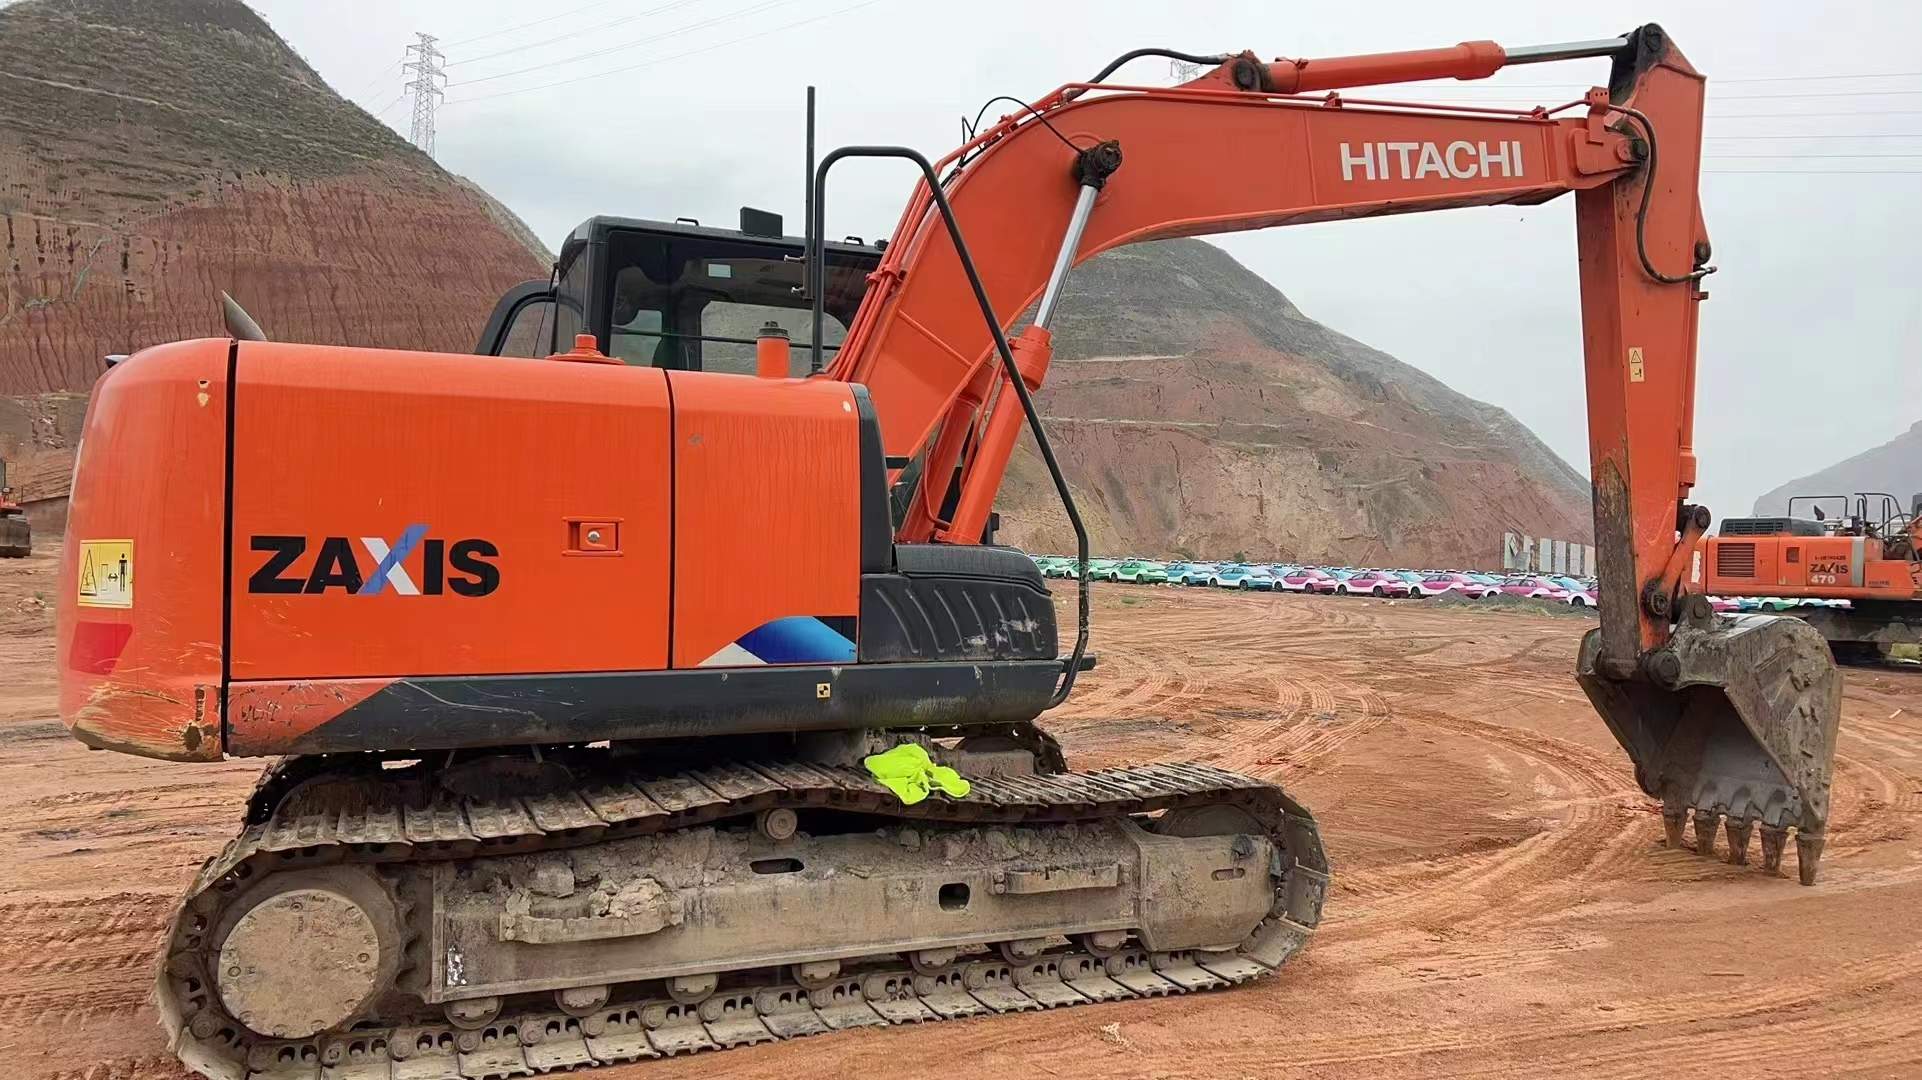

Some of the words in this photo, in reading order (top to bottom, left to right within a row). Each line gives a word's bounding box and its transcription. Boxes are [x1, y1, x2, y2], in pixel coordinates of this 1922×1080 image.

[1340, 141, 1523, 181] HITACHI
[249, 524, 500, 597] ZAXIS
[1809, 562, 1848, 574] ZAXIS
[1811, 575, 1836, 584] 470
